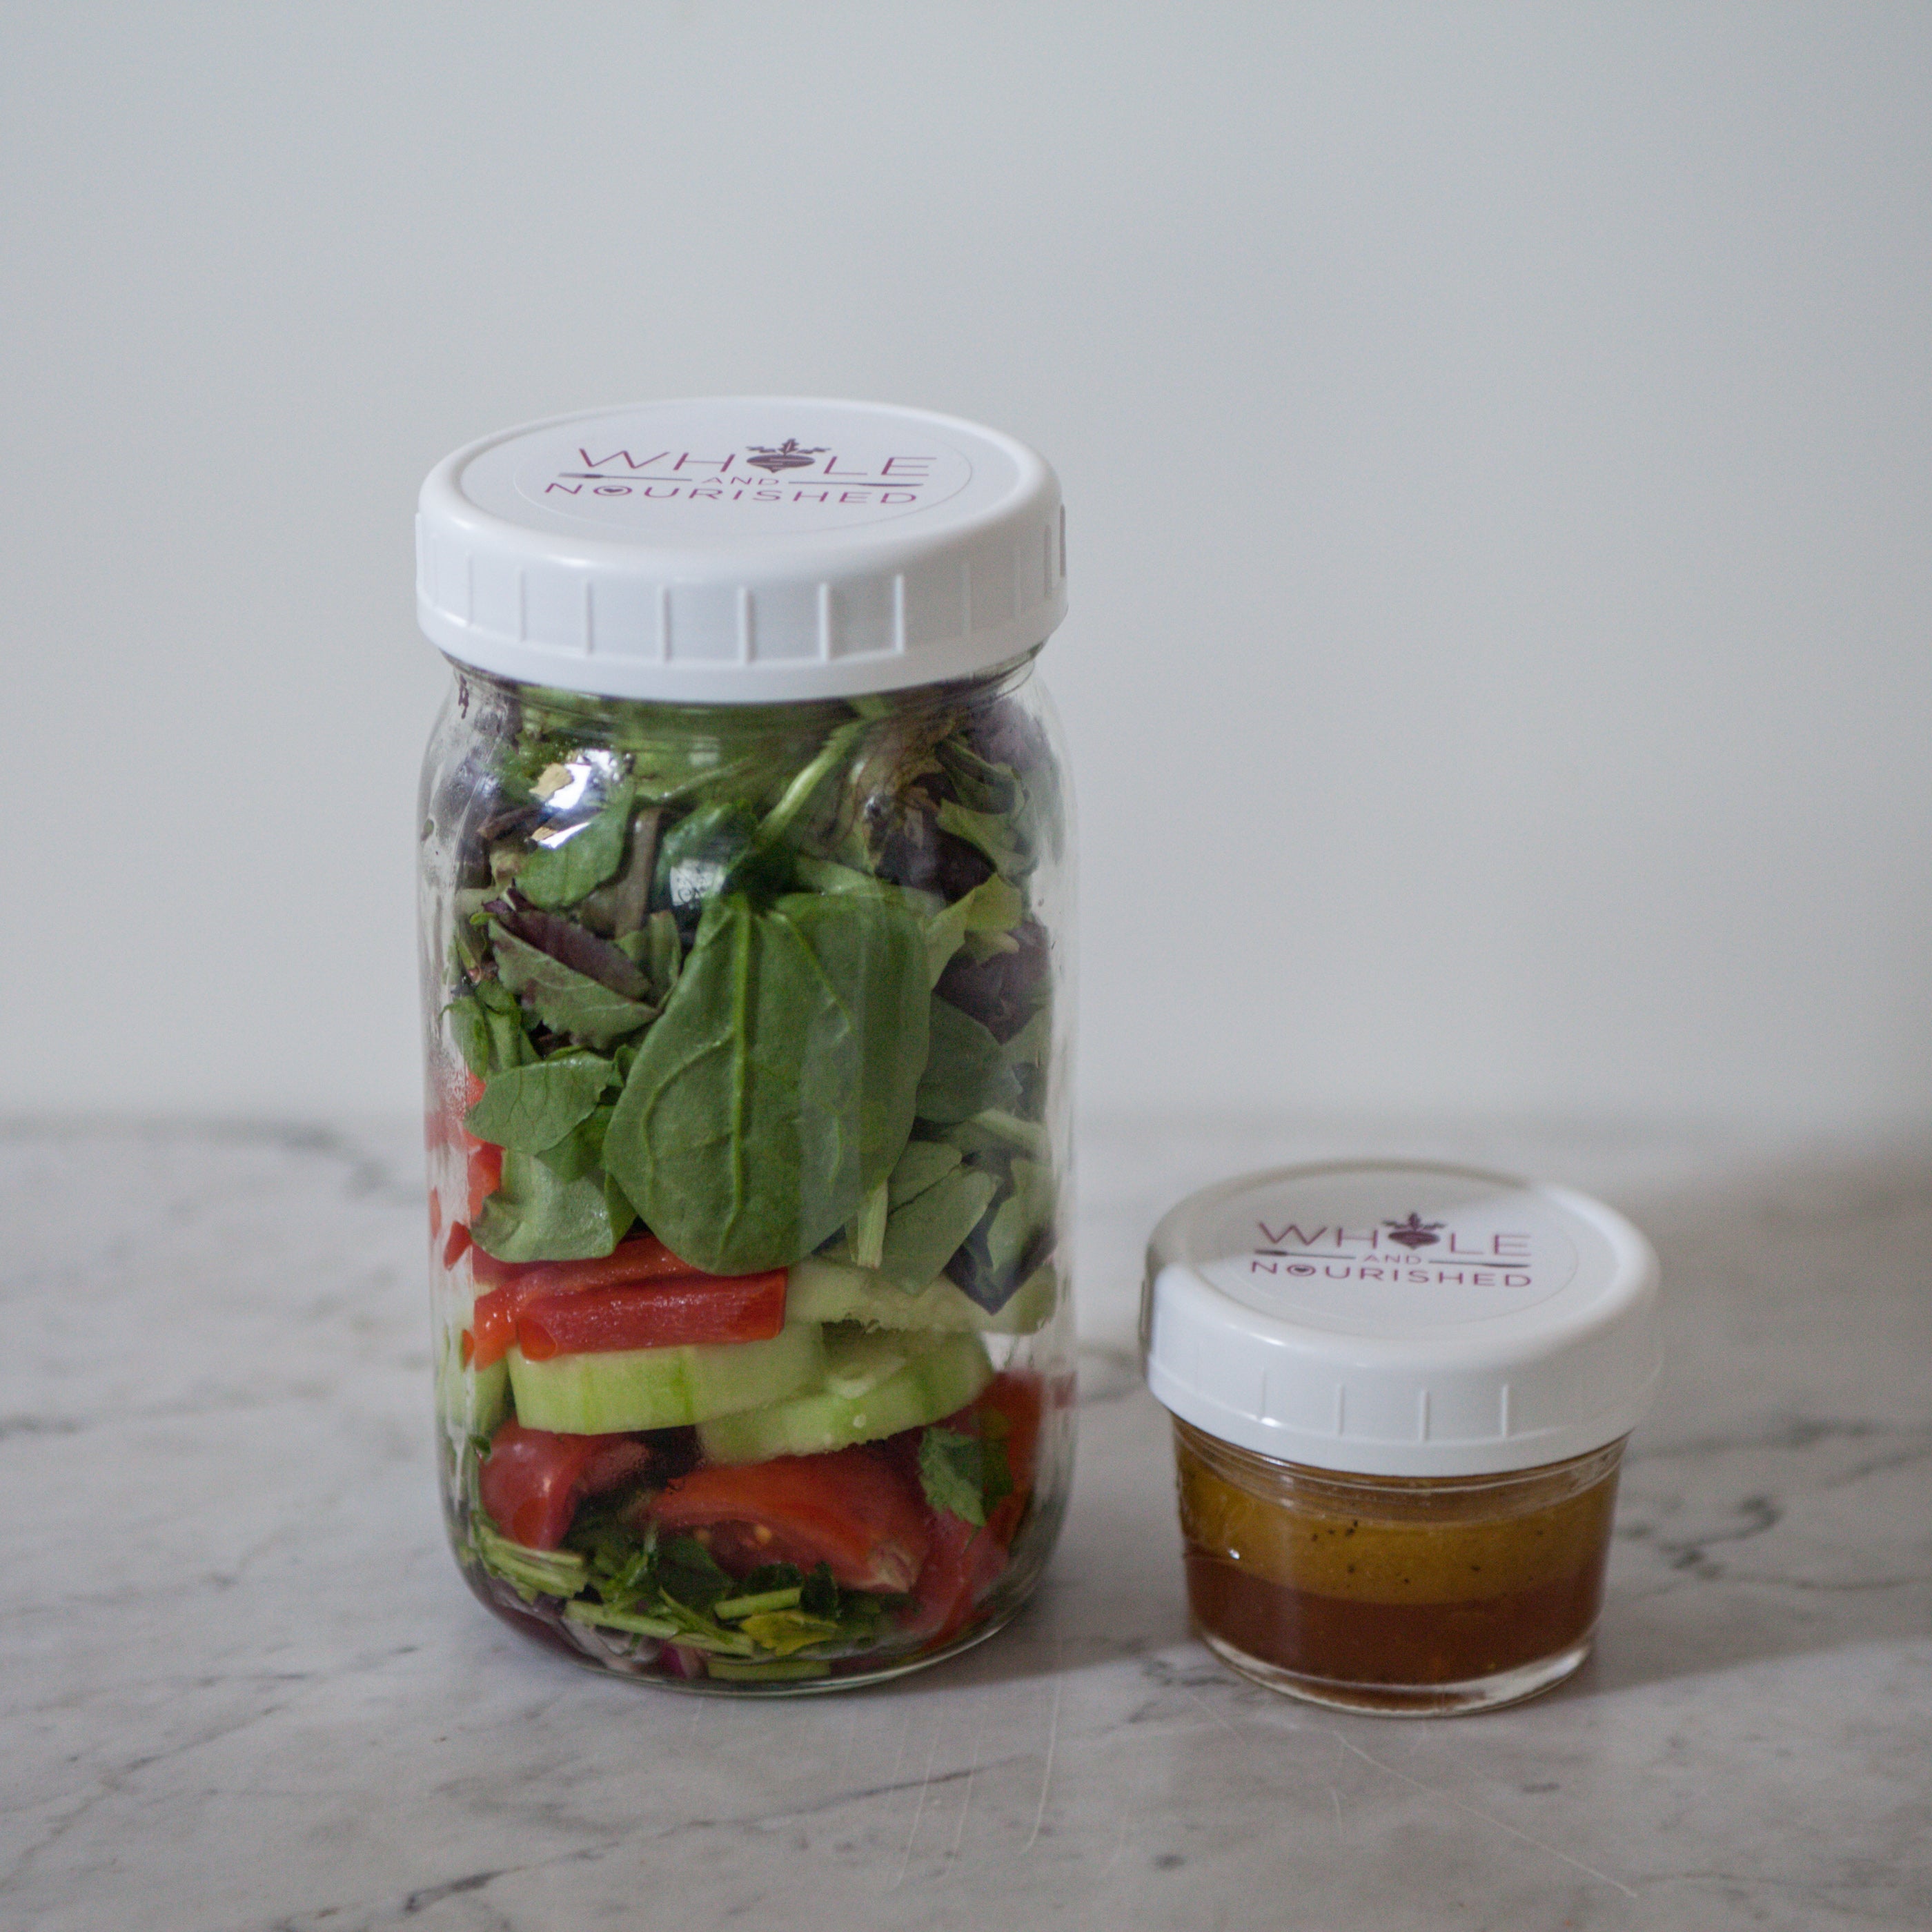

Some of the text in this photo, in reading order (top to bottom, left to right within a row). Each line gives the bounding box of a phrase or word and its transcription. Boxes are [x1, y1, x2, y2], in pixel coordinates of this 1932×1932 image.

[701, 476, 780, 485] AND
[544, 482, 917, 504] NOURISHED
[1363, 1254, 1422, 1265] AND
[1251, 1261, 1532, 1288] NOURISHED
